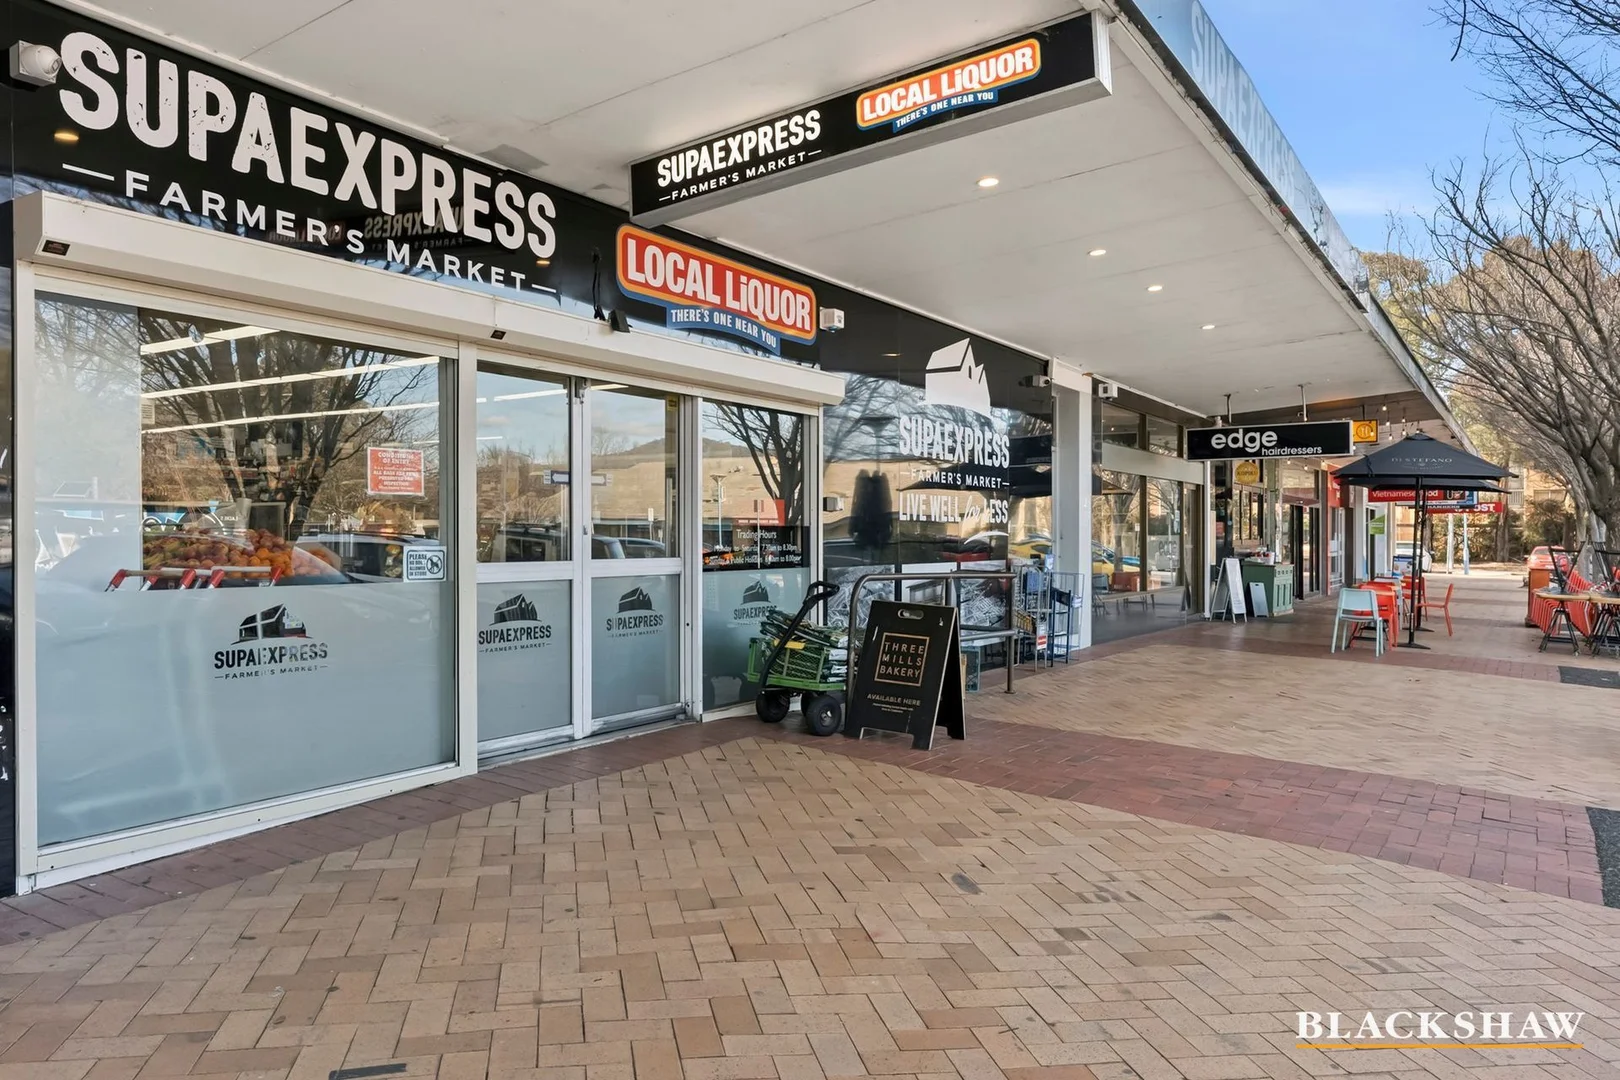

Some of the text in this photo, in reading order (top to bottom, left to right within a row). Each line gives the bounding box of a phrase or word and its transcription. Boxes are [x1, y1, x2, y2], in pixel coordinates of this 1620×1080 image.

[863, 78, 937, 121] LOCAL
[896, 91, 994, 128] THERE'S ONE NEAR YOU
[59, 31, 557, 259] SUPAEXPRESS
[657, 109, 821, 187] SUPAEXPRESS
[671, 152, 806, 200] FARMER'S MARKET
[125, 169, 526, 292] FARMER'S MARKET
[627, 238, 721, 305] LOCAL
[671, 308, 777, 348] THERE'S ONE NEAR YOU
[899, 415, 1010, 468] SUPAEXPRESS
[1210, 428, 1278, 453] edge
[1261, 445, 1323, 456] hairdressers
[911, 468, 1002, 488] FARMER'S MARKET
[899, 493, 927, 521] LIVE
[930, 495, 961, 522] WELL
[983, 498, 1009, 524] LESS
[736, 529, 777, 541] Trading Hours
[478, 624, 552, 645] SUPAEXPRESS
[485, 645, 518, 653] FARMER'S
[881, 653, 922, 666] MILLS
[884, 641, 925, 654] THREE
[280, 665, 318, 674] MARKET
[879, 665, 921, 678] BAKERY
[867, 693, 921, 706] AVAILABLE HERE
